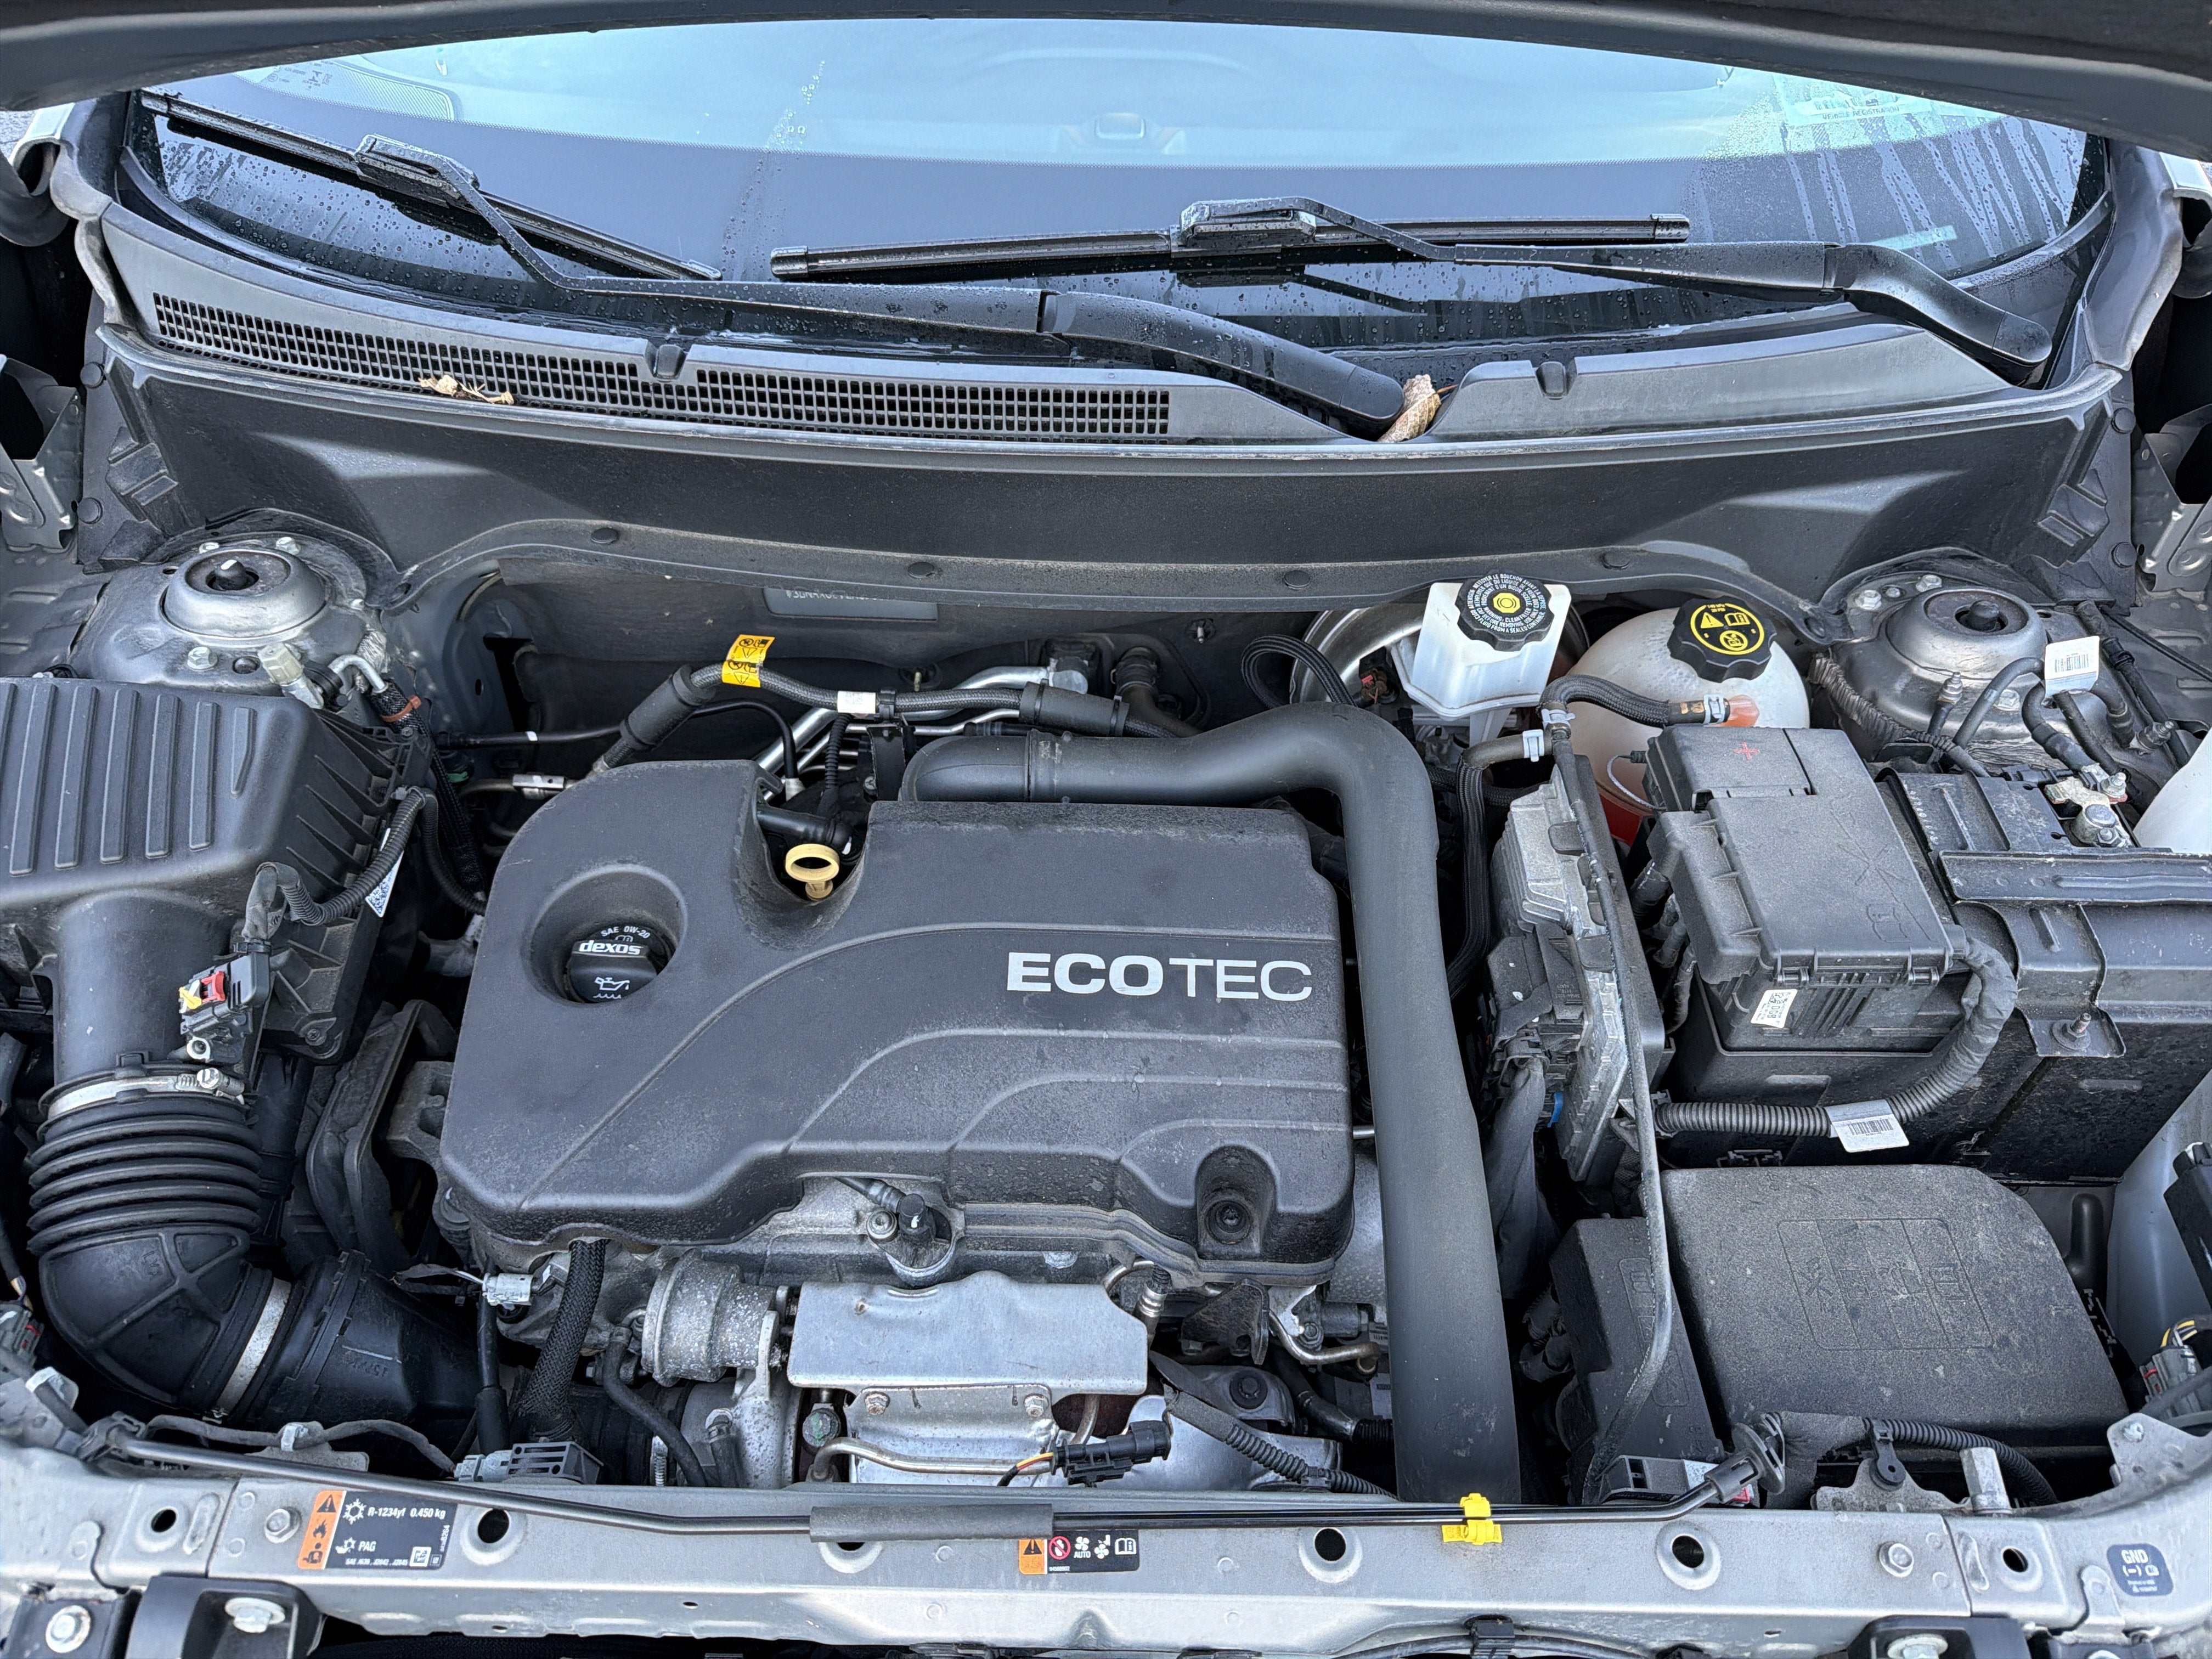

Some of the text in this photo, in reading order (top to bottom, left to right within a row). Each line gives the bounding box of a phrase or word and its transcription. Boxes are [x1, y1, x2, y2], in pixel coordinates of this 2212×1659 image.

[1500, 573, 1523, 582] BOUCHON
[1522, 579, 1537, 590] AVANT
[1508, 584, 1522, 594] BIDON
[1525, 587, 1536, 599] FREIN
[1470, 609, 1480, 619] DOT3
[1477, 618, 1491, 628] FLUID
[1482, 614, 1499, 626] BEFORE
[1530, 608, 1539, 618] ONLY
[1519, 607, 1532, 619] FILLER
[600, 926, 651, 939] SAE 0W-20
[579, 940, 644, 955] dexos
[1007, 952, 1312, 1002] ECOTEC
[368, 1507, 446, 1520] R-1234yf 0.450 kg
[358, 1541, 377, 1552] PAG
[2121, 1549, 2148, 1564] GND
